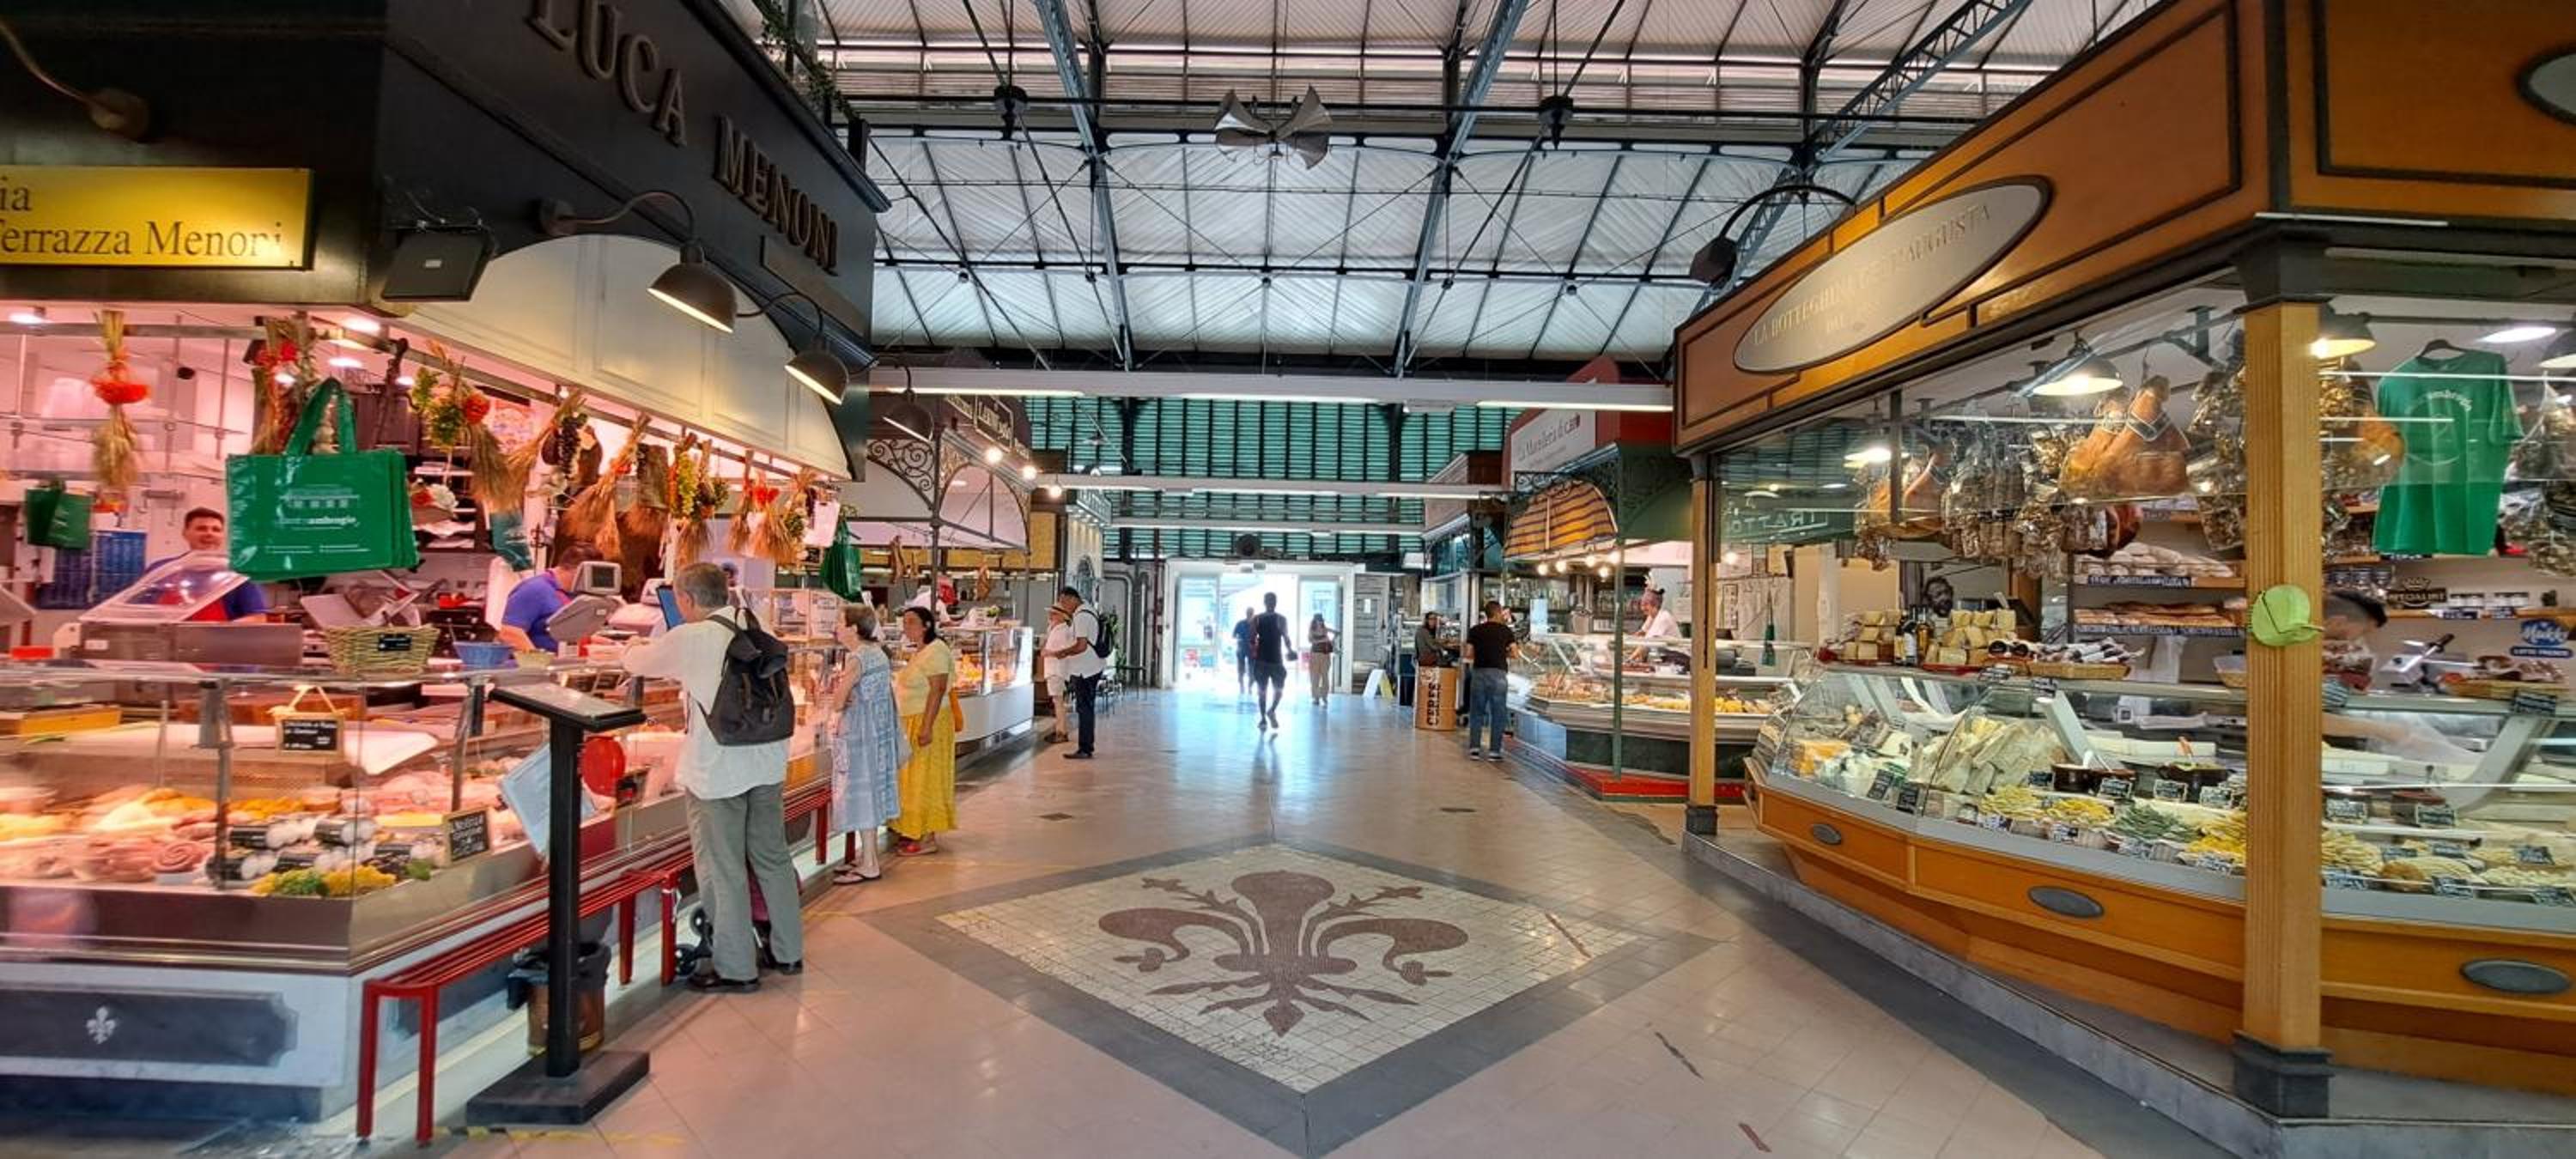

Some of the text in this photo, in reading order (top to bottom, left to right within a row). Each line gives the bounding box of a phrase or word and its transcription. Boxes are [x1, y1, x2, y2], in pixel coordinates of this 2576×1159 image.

[525, 0, 838, 276] LUCA MENONI
[145, 221, 282, 257] Menoni
